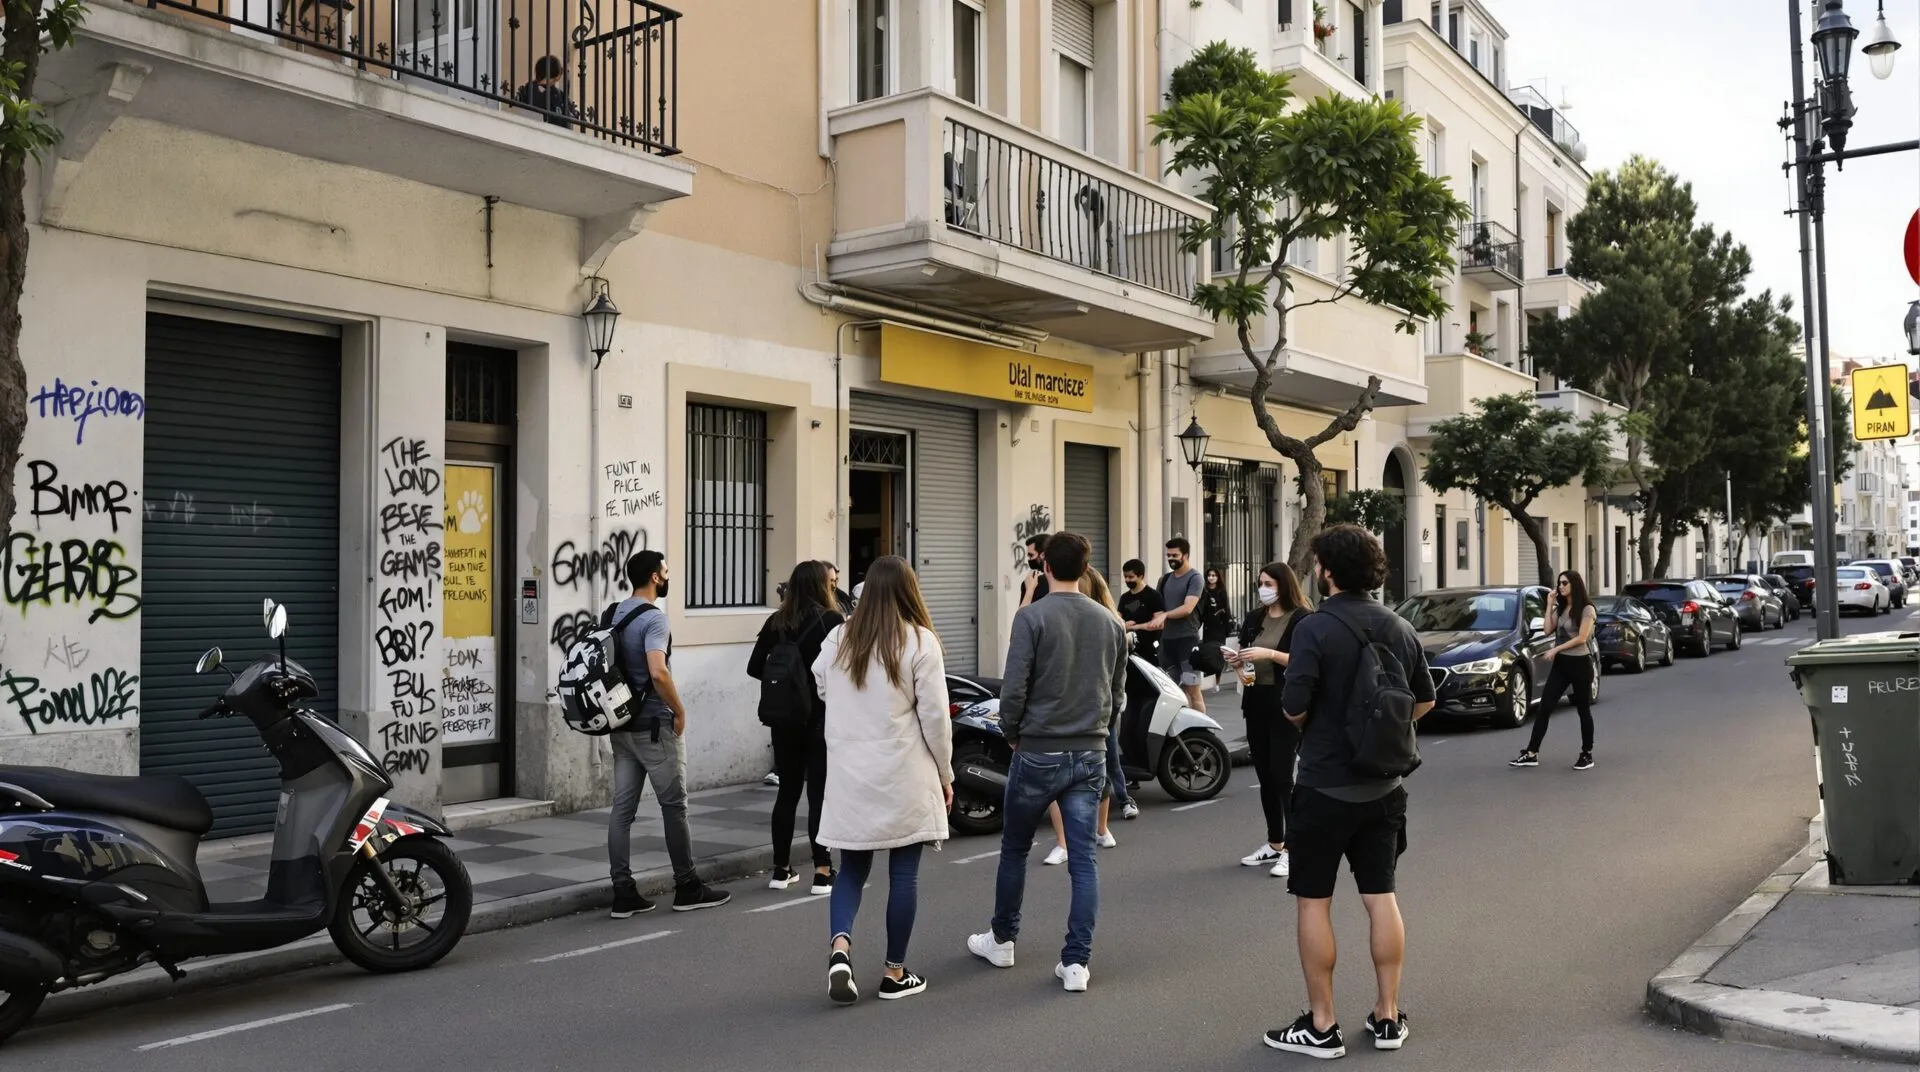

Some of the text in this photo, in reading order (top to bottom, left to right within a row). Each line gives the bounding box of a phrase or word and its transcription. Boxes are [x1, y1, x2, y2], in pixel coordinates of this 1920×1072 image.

[1867, 421, 1895, 434] PIRAN
[381, 436, 431, 468] THE
[640, 462, 651, 475] IN
[384, 467, 440, 497] LOND
[400, 533, 416, 546] THE
